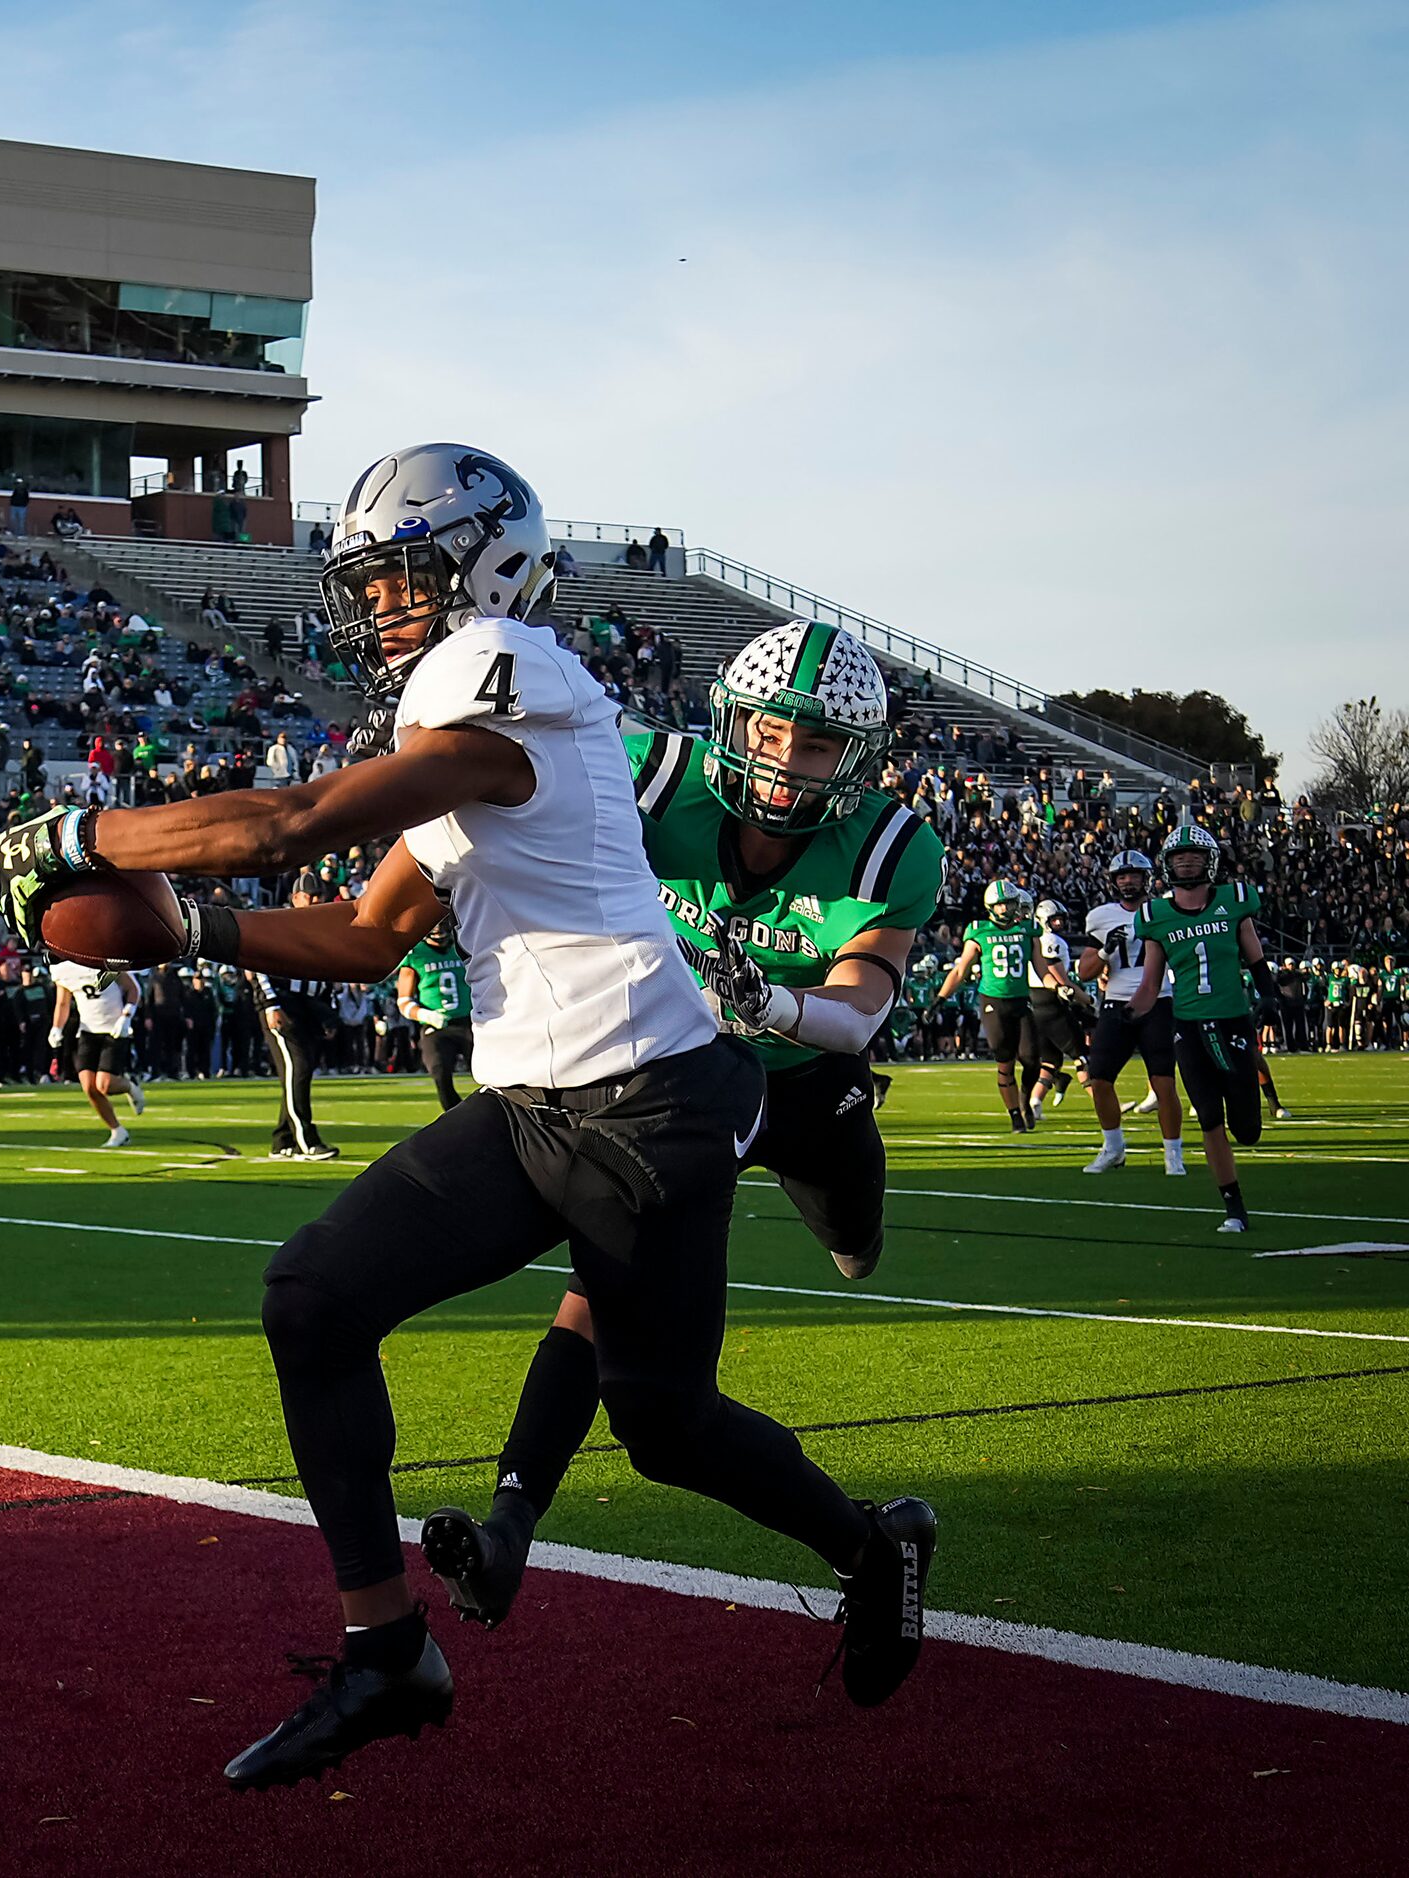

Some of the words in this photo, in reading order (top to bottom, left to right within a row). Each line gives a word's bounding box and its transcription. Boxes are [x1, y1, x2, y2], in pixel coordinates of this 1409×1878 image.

[473, 652, 522, 714] 4
[789, 901, 825, 924] adidas
[1167, 921, 1229, 943] DRAGONS
[992, 944, 1024, 978] 93
[1195, 942, 1211, 994] 1
[439, 971, 459, 1010] 9
[835, 1093, 867, 1116] adidas
[900, 1541, 919, 1640] BATTLE
